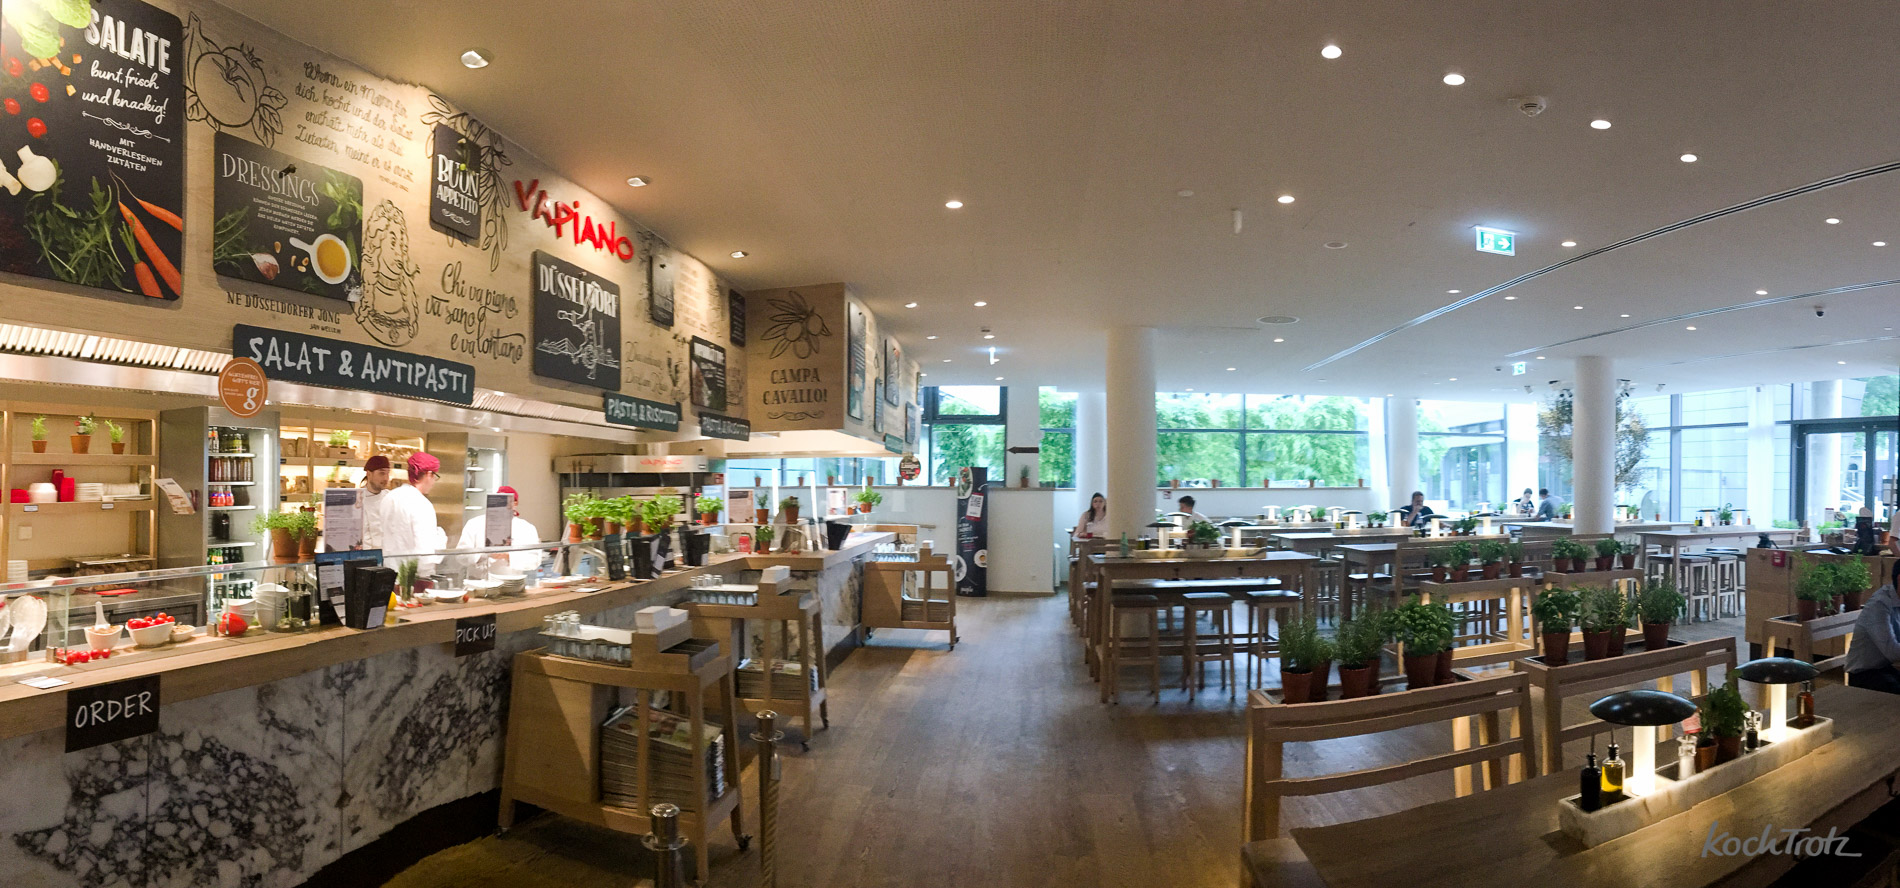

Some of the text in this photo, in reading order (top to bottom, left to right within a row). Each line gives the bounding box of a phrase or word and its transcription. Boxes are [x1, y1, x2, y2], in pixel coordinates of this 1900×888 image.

[84, 8, 171, 75] SALATE
[125, 68, 160, 90] frisch
[82, 88, 169, 125] und knackig!
[89, 138, 163, 167] HANDVERLESENEN
[119, 138, 136, 148] MIT
[106, 155, 147, 172] ZUTATEN
[437, 154, 480, 198] BUON
[222, 153, 320, 206] DRESSINGS
[436, 184, 478, 216] APPETITO
[441, 261, 466, 297] Chi
[469, 286, 484, 304] va
[539, 264, 619, 318] DÜSSELDORF
[226, 291, 340, 325] NE DÜSSELDORFER JONG
[450, 333, 459, 350] e
[461, 338, 477, 359] va
[249, 336, 468, 394] SALAT & ANTIPASTI
[770, 367, 821, 385] CAMPA
[243, 387, 260, 410] g
[607, 399, 639, 422] PASTA
[762, 388, 828, 405] CAVALLO!
[456, 623, 496, 644] PICK UP
[75, 691, 153, 729] ORDER
